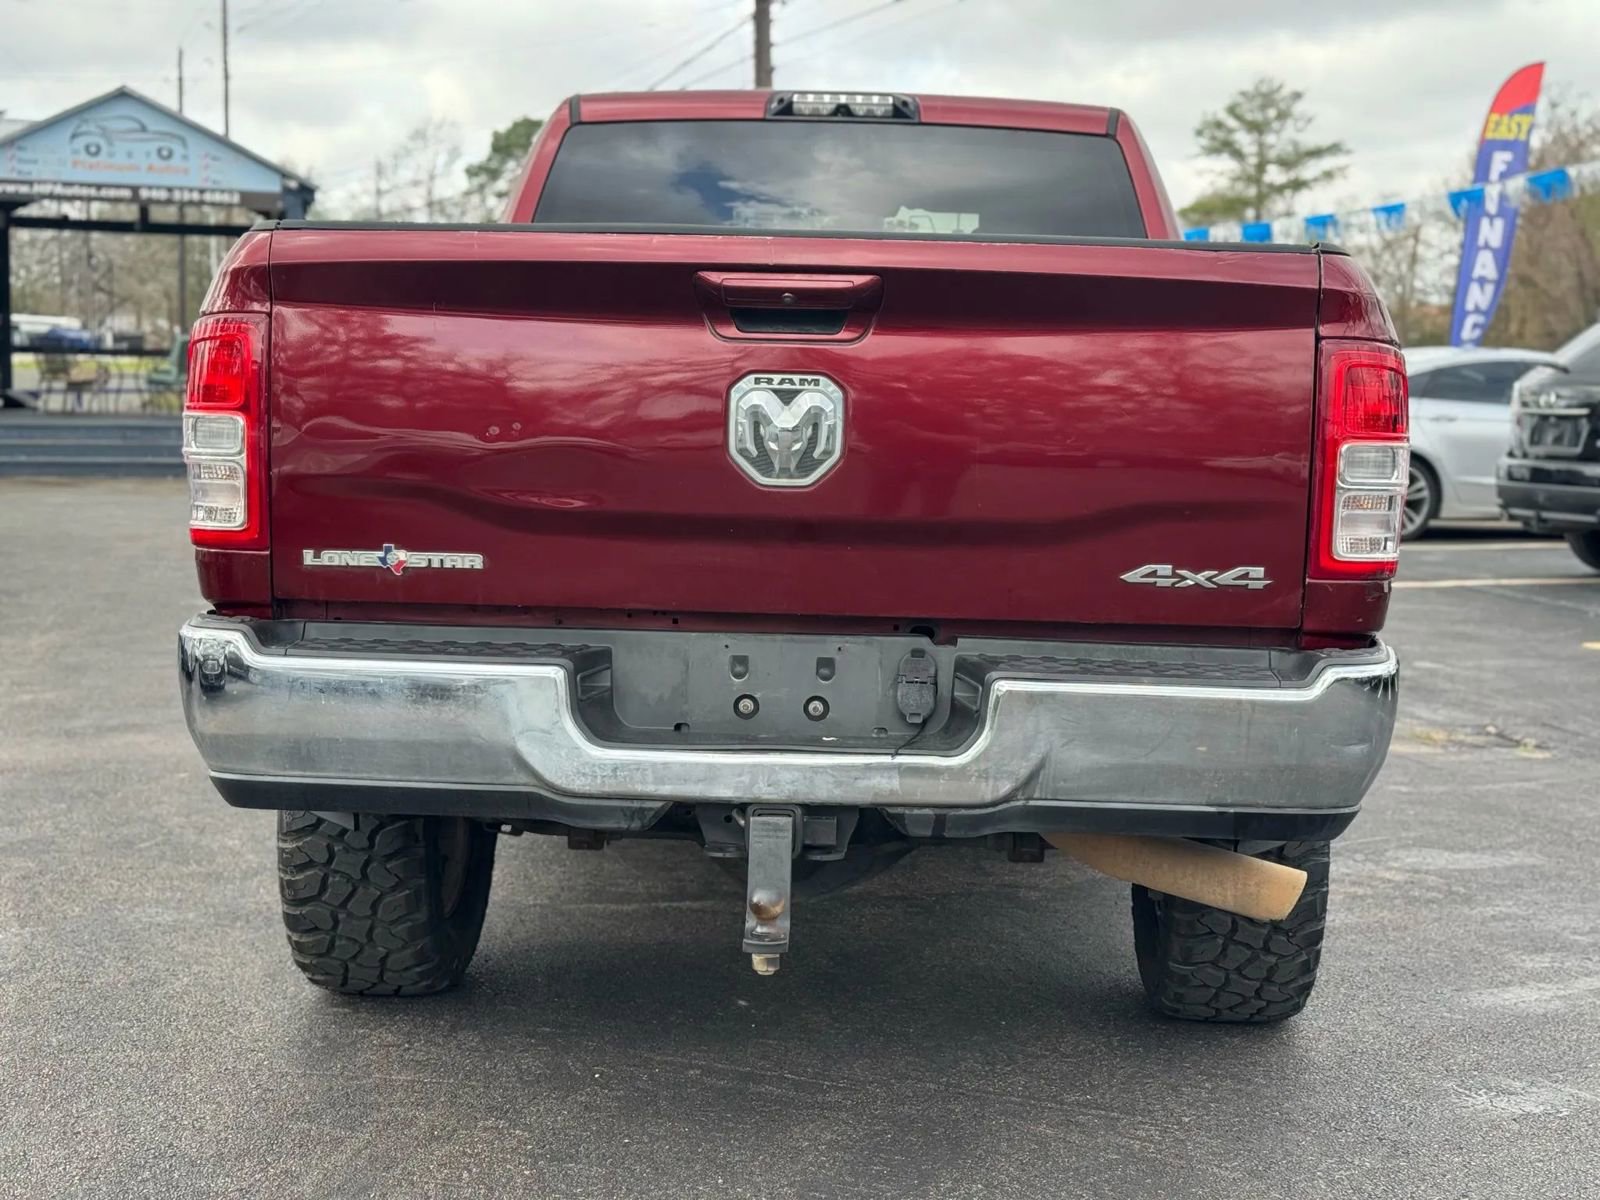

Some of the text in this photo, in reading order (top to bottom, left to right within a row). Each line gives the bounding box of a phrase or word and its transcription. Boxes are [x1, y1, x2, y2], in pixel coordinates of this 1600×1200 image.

[1485, 112, 1533, 140] EASY
[1460, 151, 1514, 347] FINANC
[754, 377, 820, 387] RAM
[303, 549, 484, 569] LONE STAR
[1119, 564, 1273, 589] 4x4
